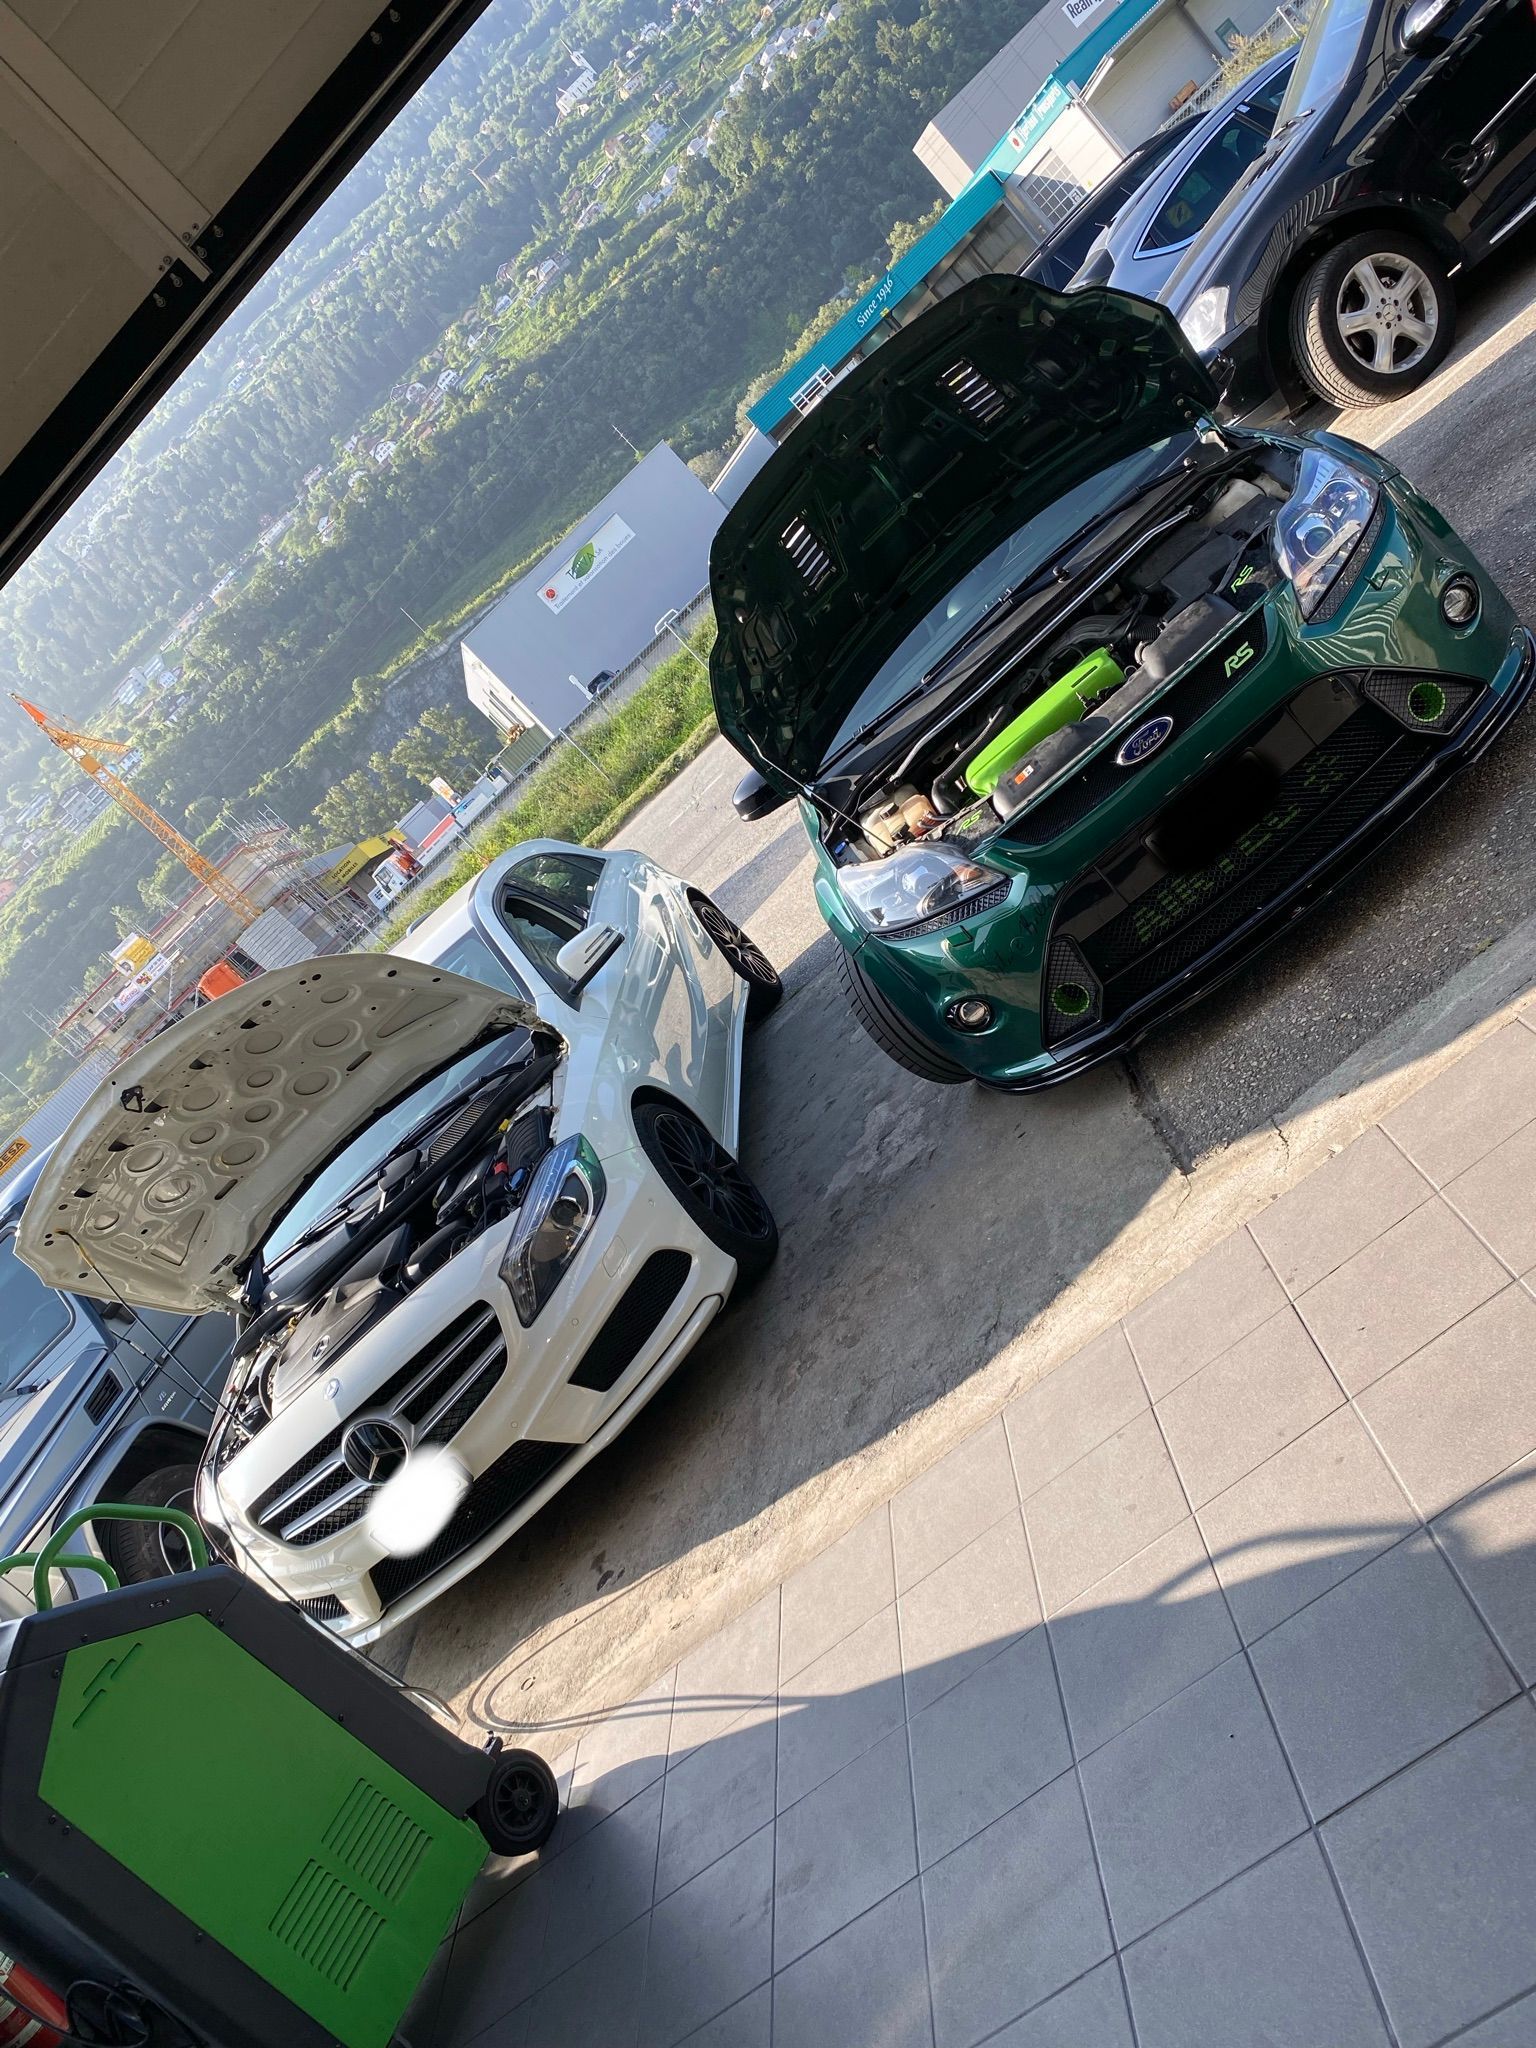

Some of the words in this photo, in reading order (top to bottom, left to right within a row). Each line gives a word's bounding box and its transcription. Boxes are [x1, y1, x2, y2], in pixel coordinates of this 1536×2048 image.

[857, 299, 877, 327] Since
[876, 274, 893, 301] 1946
[554, 585, 579, 609] Traitement
[583, 555, 609, 582] valorisation
[1230, 564, 1254, 594] RS
[1223, 641, 1255, 679] RS
[1131, 728, 1162, 756] Ford
[955, 809, 983, 836] RS
[331, 859, 351, 879] LOCATION
